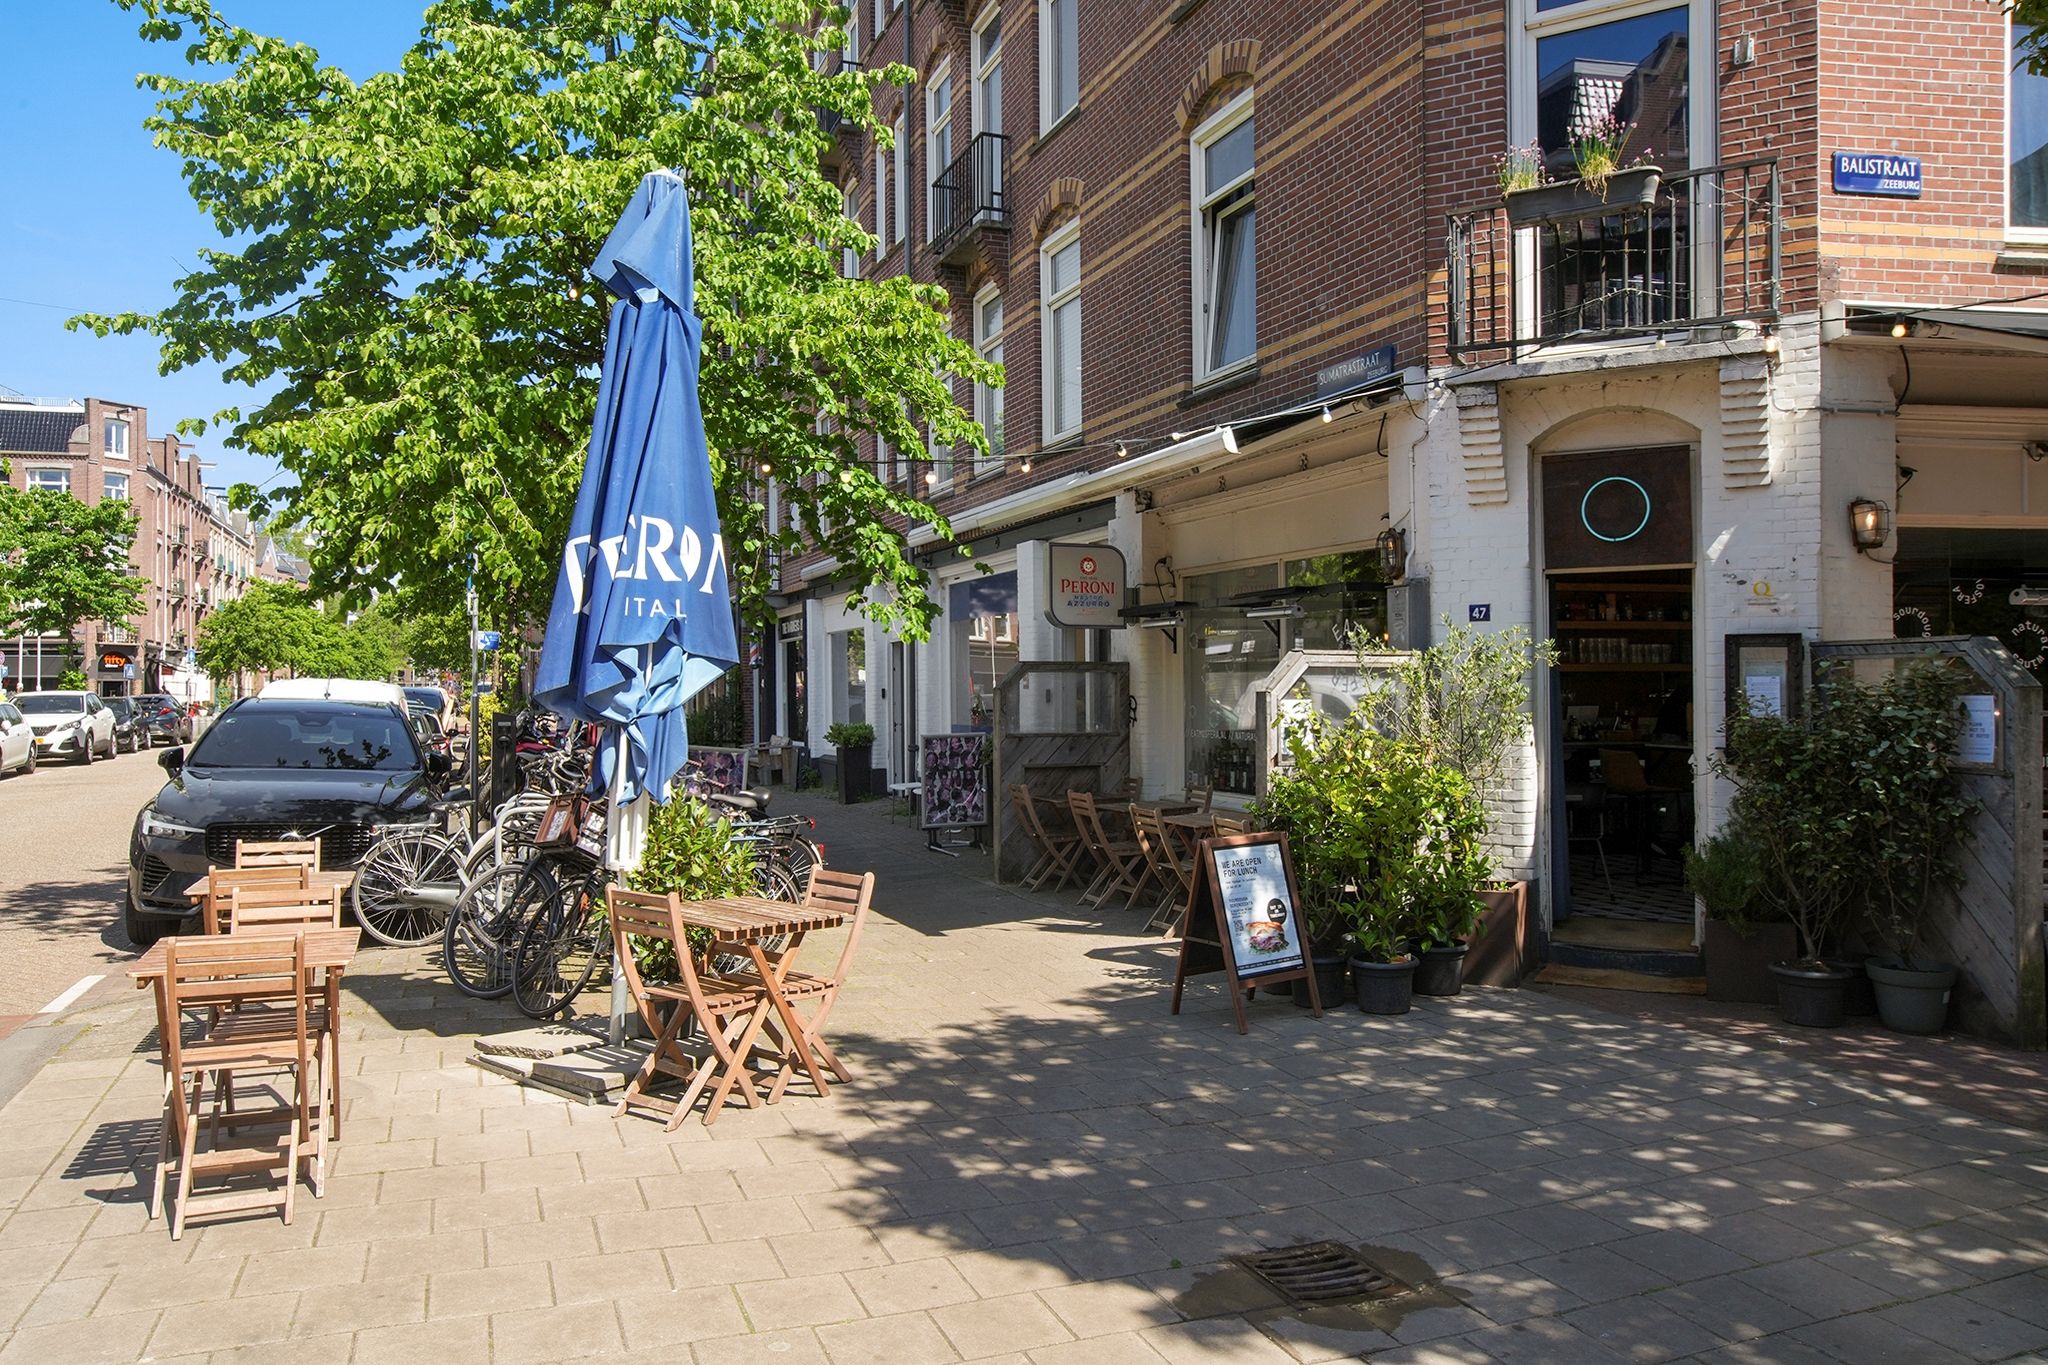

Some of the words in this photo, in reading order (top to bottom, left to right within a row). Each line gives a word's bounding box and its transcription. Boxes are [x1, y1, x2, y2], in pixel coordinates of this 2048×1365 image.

[1841, 157, 1917, 177] BALISTRAAT
[1883, 180, 1919, 189] ZEEBURG
[1319, 352, 1380, 386] SUMATRASTRAAT
[1061, 578, 1115, 595] PERONI
[1067, 600, 1110, 608] AZZURRO
[1472, 607, 1487, 619] 47
[103, 655, 126, 667] fifty
[1221, 860, 1230, 869] WE
[1232, 859, 1244, 868] ARE
[1245, 857, 1262, 867] OPEN
[1223, 869, 1237, 878] FOR
[1237, 866, 1258, 877] LUNCH
